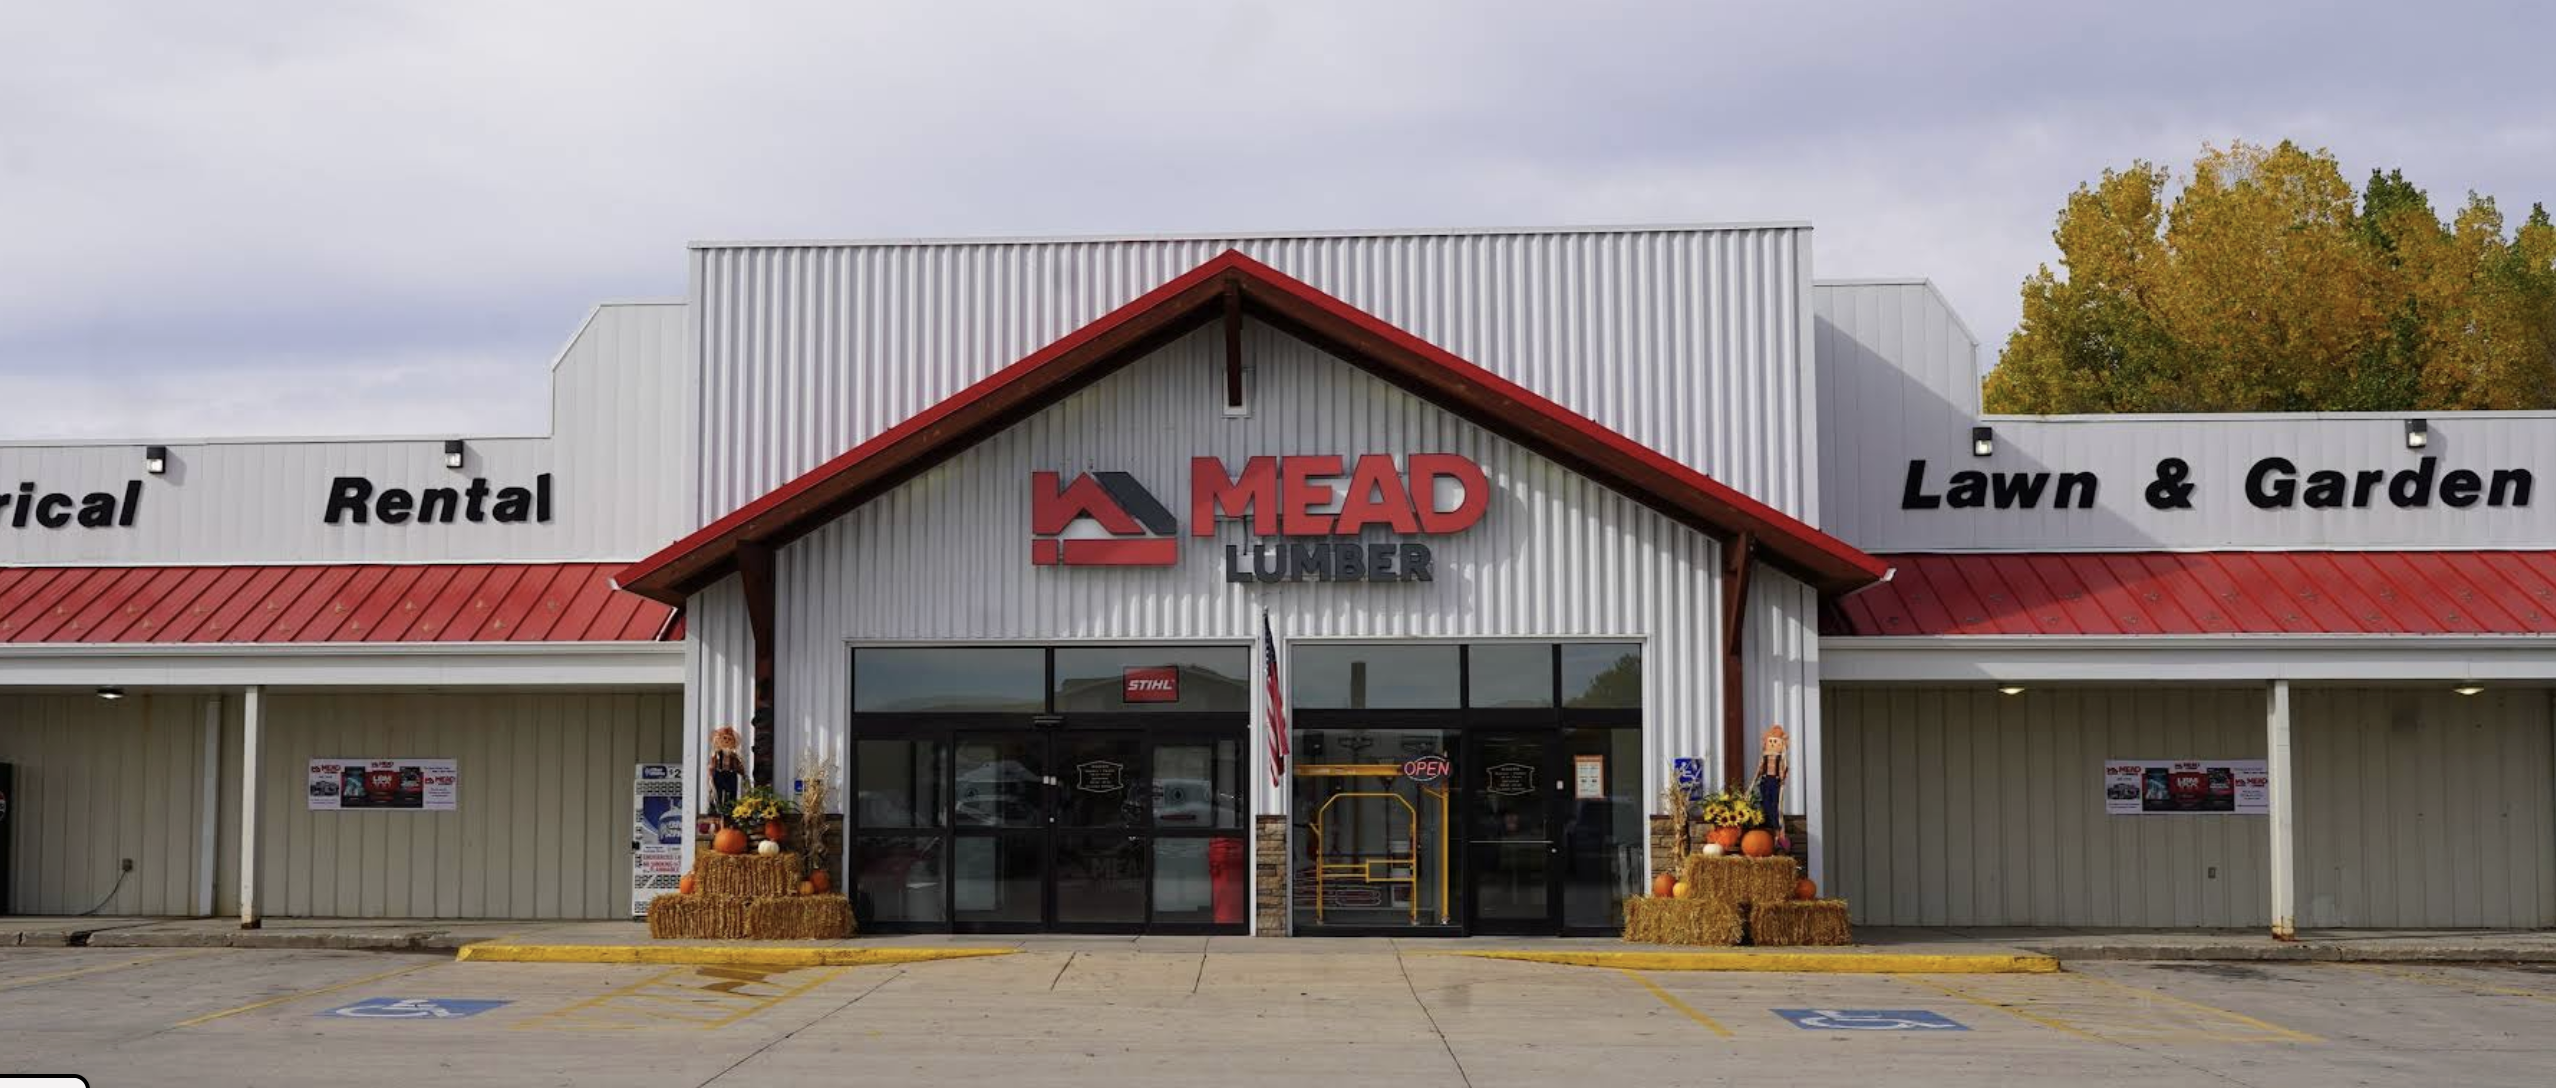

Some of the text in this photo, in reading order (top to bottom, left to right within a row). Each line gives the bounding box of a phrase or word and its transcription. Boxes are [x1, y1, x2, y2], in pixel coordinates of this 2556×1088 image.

[324, 473, 551, 524] Rental
[1191, 453, 1490, 537] MEAD
[1902, 456, 2533, 510] Lawn & Garden
[1226, 543, 1433, 583] LUMBER
[1128, 679, 1173, 691] STIHL
[1404, 761, 1450, 776] OPEN
